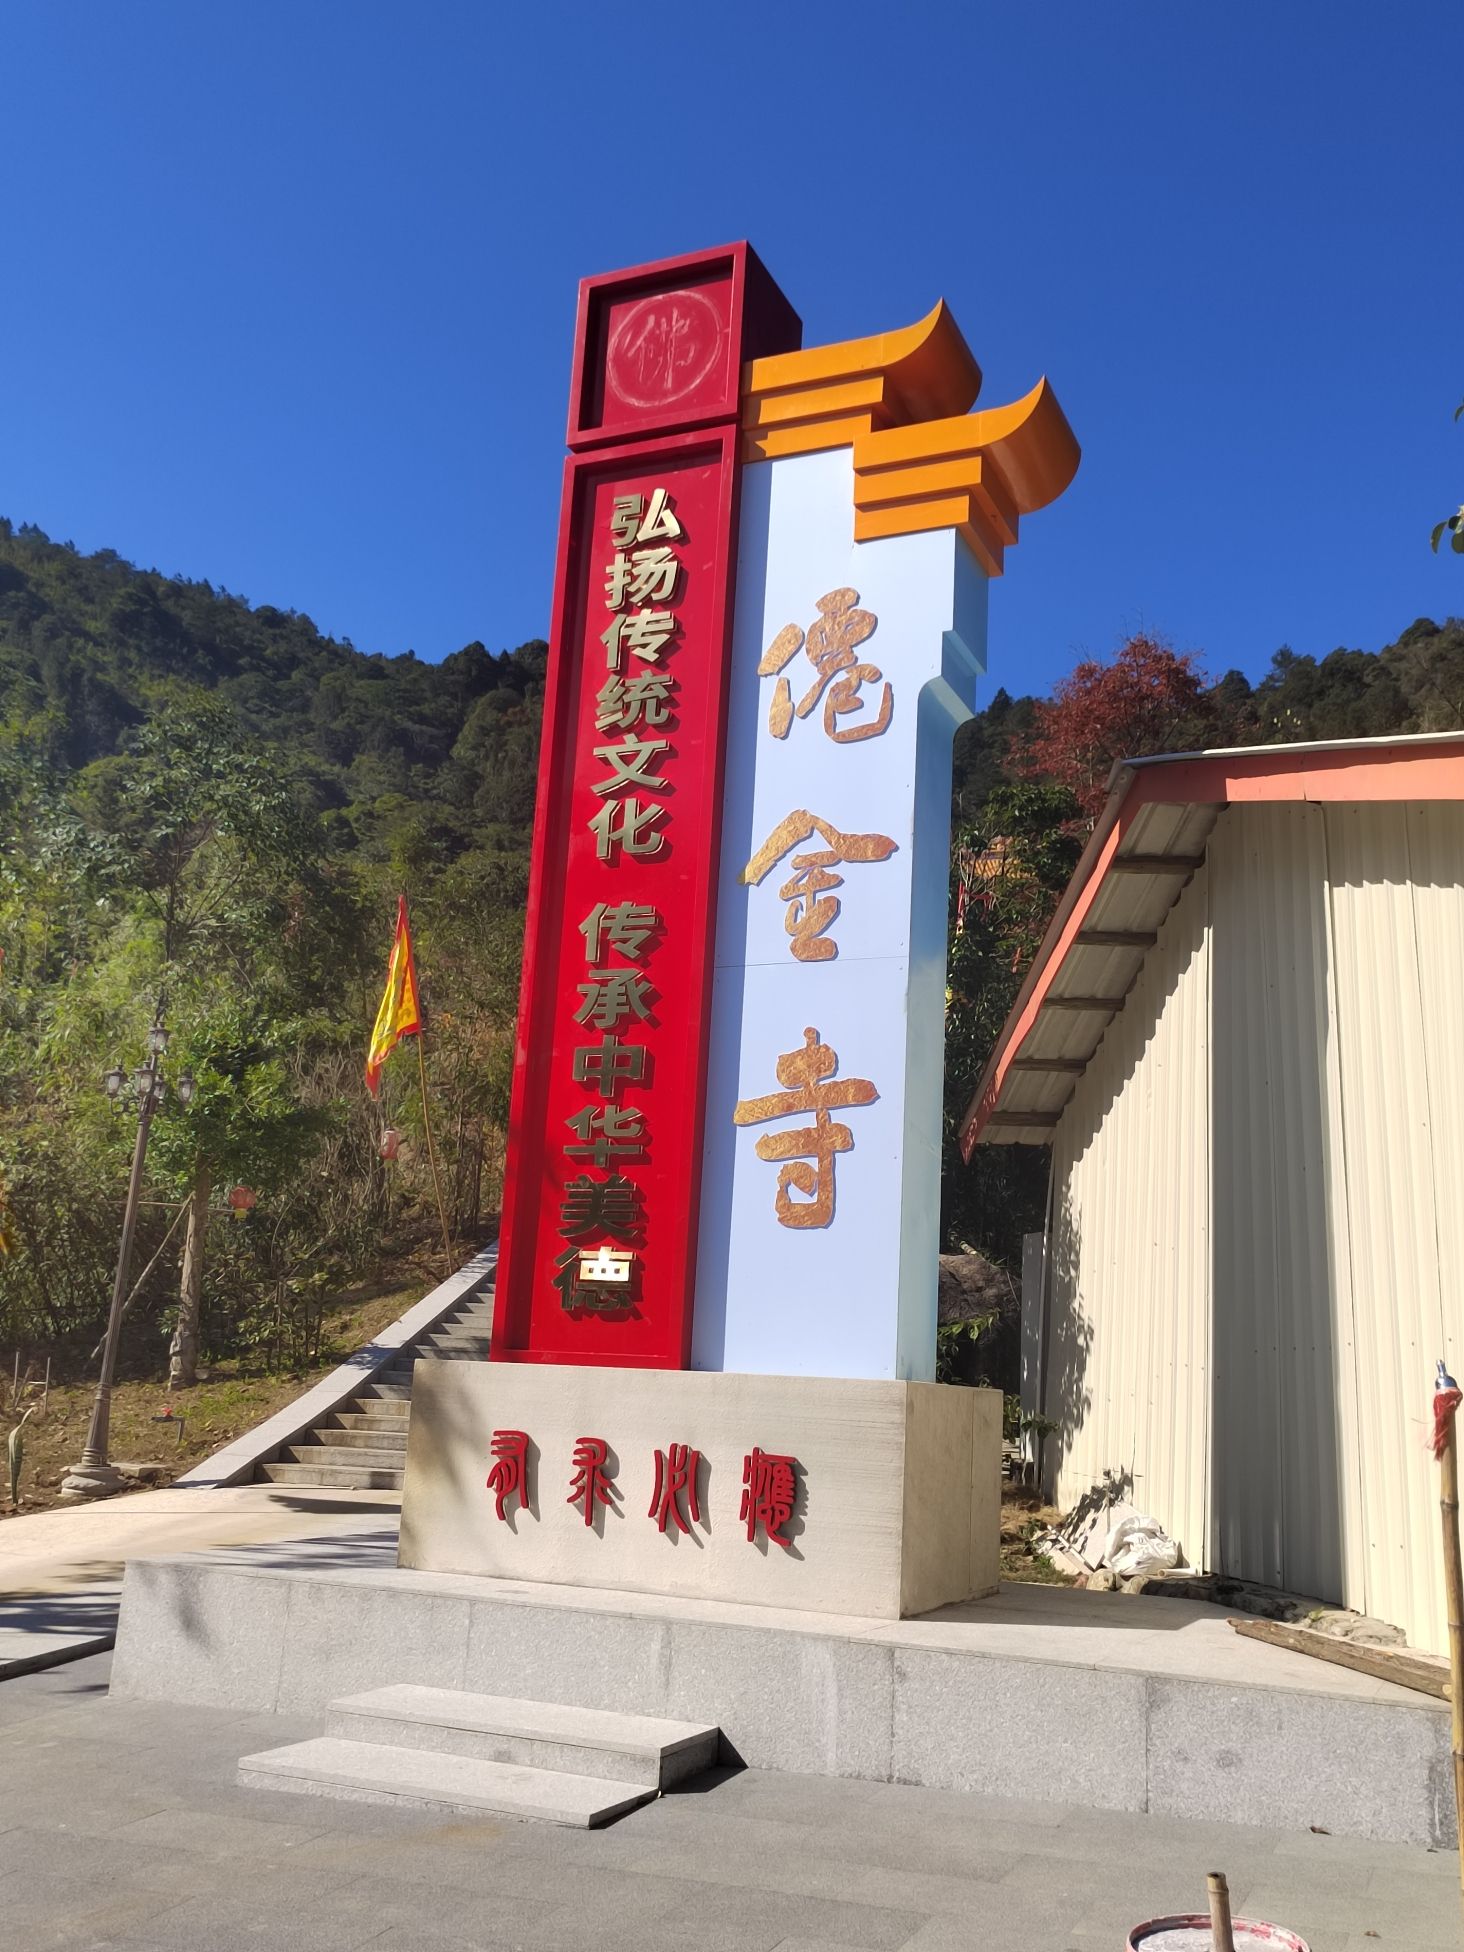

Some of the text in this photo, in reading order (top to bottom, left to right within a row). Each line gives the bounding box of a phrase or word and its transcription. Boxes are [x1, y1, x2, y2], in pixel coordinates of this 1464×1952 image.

[552, 488, 682, 1311] 弘扬传统文化 传承中华美德
